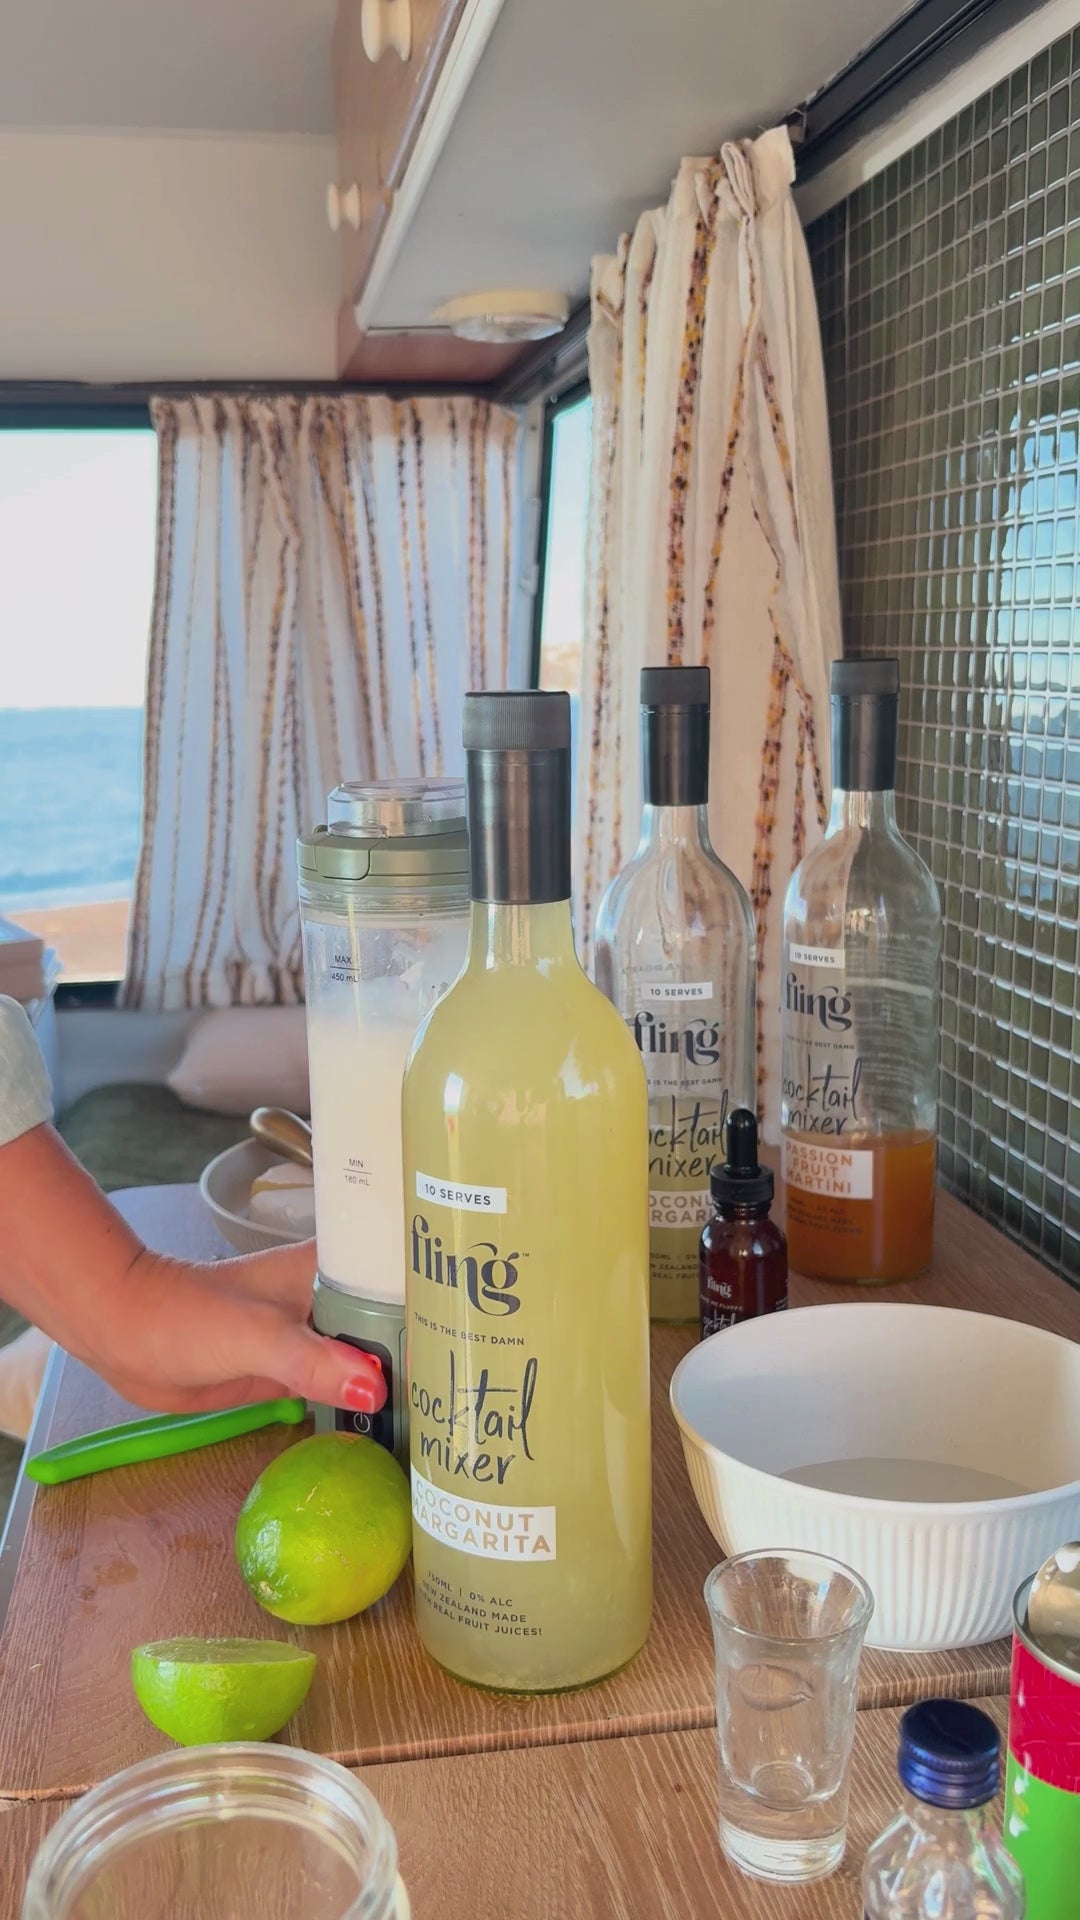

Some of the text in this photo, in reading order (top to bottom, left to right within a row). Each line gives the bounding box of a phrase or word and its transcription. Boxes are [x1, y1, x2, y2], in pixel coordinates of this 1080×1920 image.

[334, 955, 352, 964] MAX
[804, 954, 836, 964] SERVES
[331, 973, 358, 983] 450 mL
[650, 988, 704, 996] 10 SERVES
[786, 972, 852, 1032] fling
[634, 1011, 720, 1066] fling
[782, 1054, 863, 1121] cocktail
[788, 1108, 848, 1136] mixer
[348, 1158, 364, 1168] MIN
[786, 1141, 853, 1167] PASSION
[793, 1158, 839, 1178] FRUIT
[344, 1175, 370, 1186] 180 mL
[787, 1168, 852, 1194] MARTINI
[425, 1184, 491, 1206] 10 SERVES
[649, 1195, 713, 1208] OCONU
[411, 1214, 521, 1317] fling
[708, 1276, 732, 1298] fling
[414, 1312, 525, 1346] THIS IS THE BEST DAMN
[411, 1349, 538, 1461] cocktail
[420, 1430, 516, 1486] mixer
[416, 1480, 535, 1532] COCONUT
[414, 1496, 551, 1554] MARGARITA
[428, 1570, 452, 1592] 750ML
[469, 1591, 486, 1603] 0%
[490, 1596, 513, 1607] ALC
[433, 1604, 456, 1620] REAL
[458, 1615, 490, 1631] FRUIT
[494, 1626, 542, 1636] JUICES!
[440, 1594, 487, 1617] ZEALAND
[492, 1612, 527, 1623] MADE
